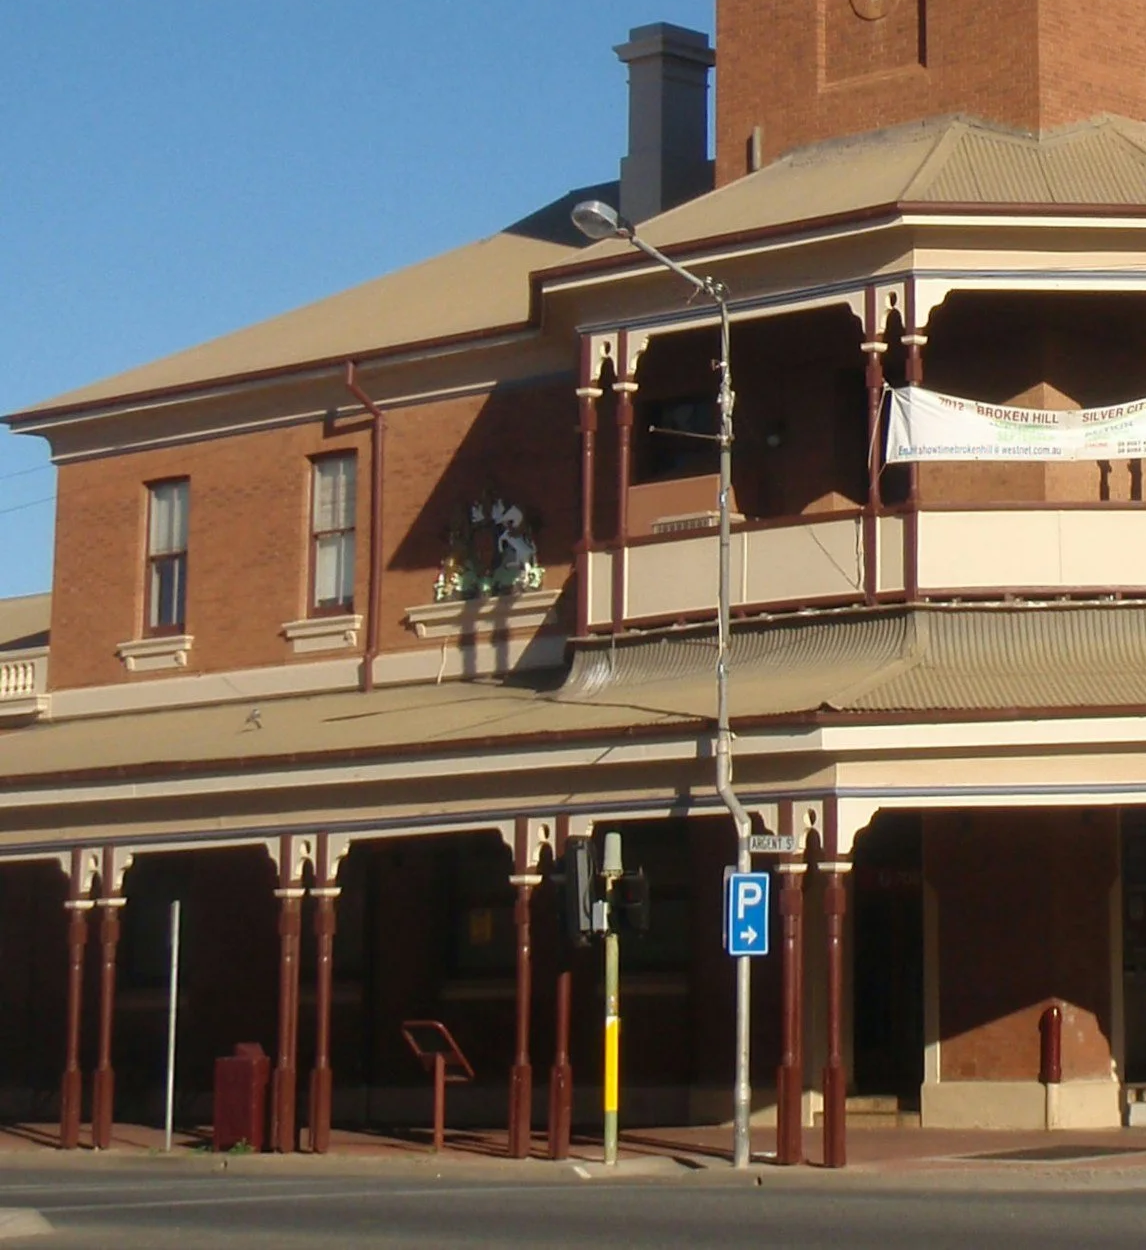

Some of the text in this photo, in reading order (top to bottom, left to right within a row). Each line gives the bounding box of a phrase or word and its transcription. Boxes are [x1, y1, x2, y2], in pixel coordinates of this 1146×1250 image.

[976, 404, 1029, 423] BROKEN
[1032, 411, 1059, 424] HILL
[1082, 407, 1124, 423] SILVER
[752, 837, 782, 850] ARGENT
[737, 882, 763, 919] P
